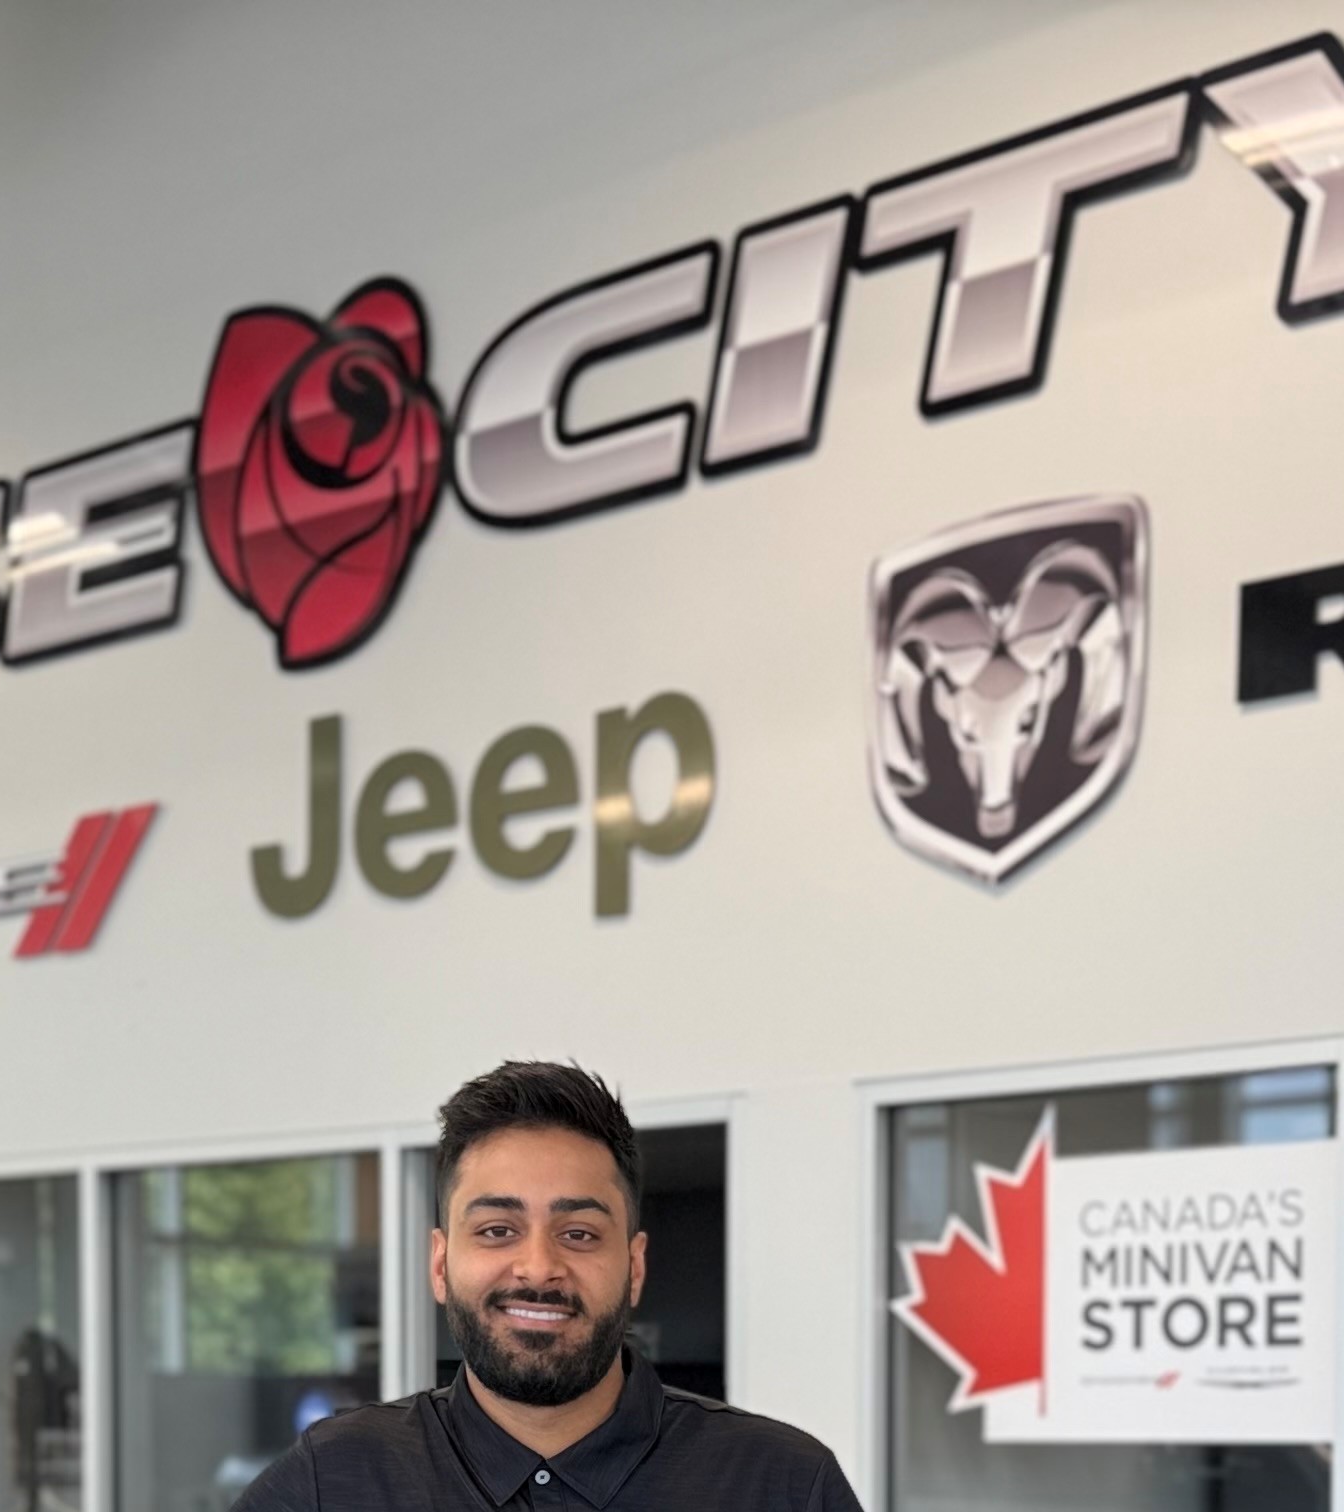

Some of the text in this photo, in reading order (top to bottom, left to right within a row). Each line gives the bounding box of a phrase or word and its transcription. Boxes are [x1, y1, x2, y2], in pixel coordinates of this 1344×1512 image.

[249, 690, 717, 920] Jeep
[1077, 1189, 1305, 1239] CANADA'S
[1080, 1237, 1305, 1289] MINIVAN
[1081, 1293, 1304, 1350] STORE
